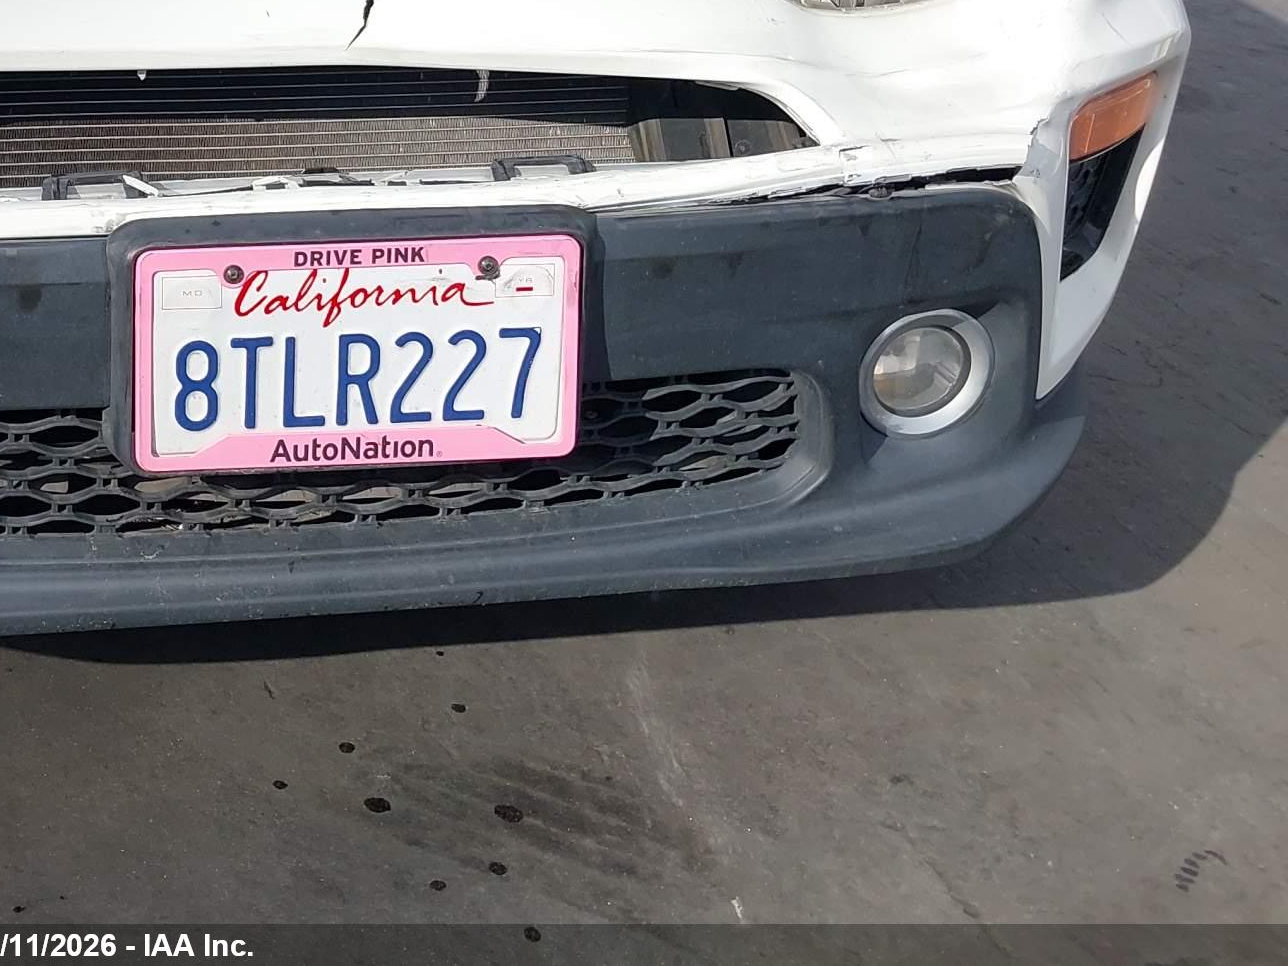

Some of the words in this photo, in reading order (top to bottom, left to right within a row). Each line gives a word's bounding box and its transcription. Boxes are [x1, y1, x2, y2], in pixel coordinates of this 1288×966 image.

[293, 248, 363, 269] DRIVE
[371, 245, 426, 265] PINK
[233, 267, 495, 329] California
[173, 325, 544, 433] 8TLR227
[269, 435, 435, 464] AutoNation
